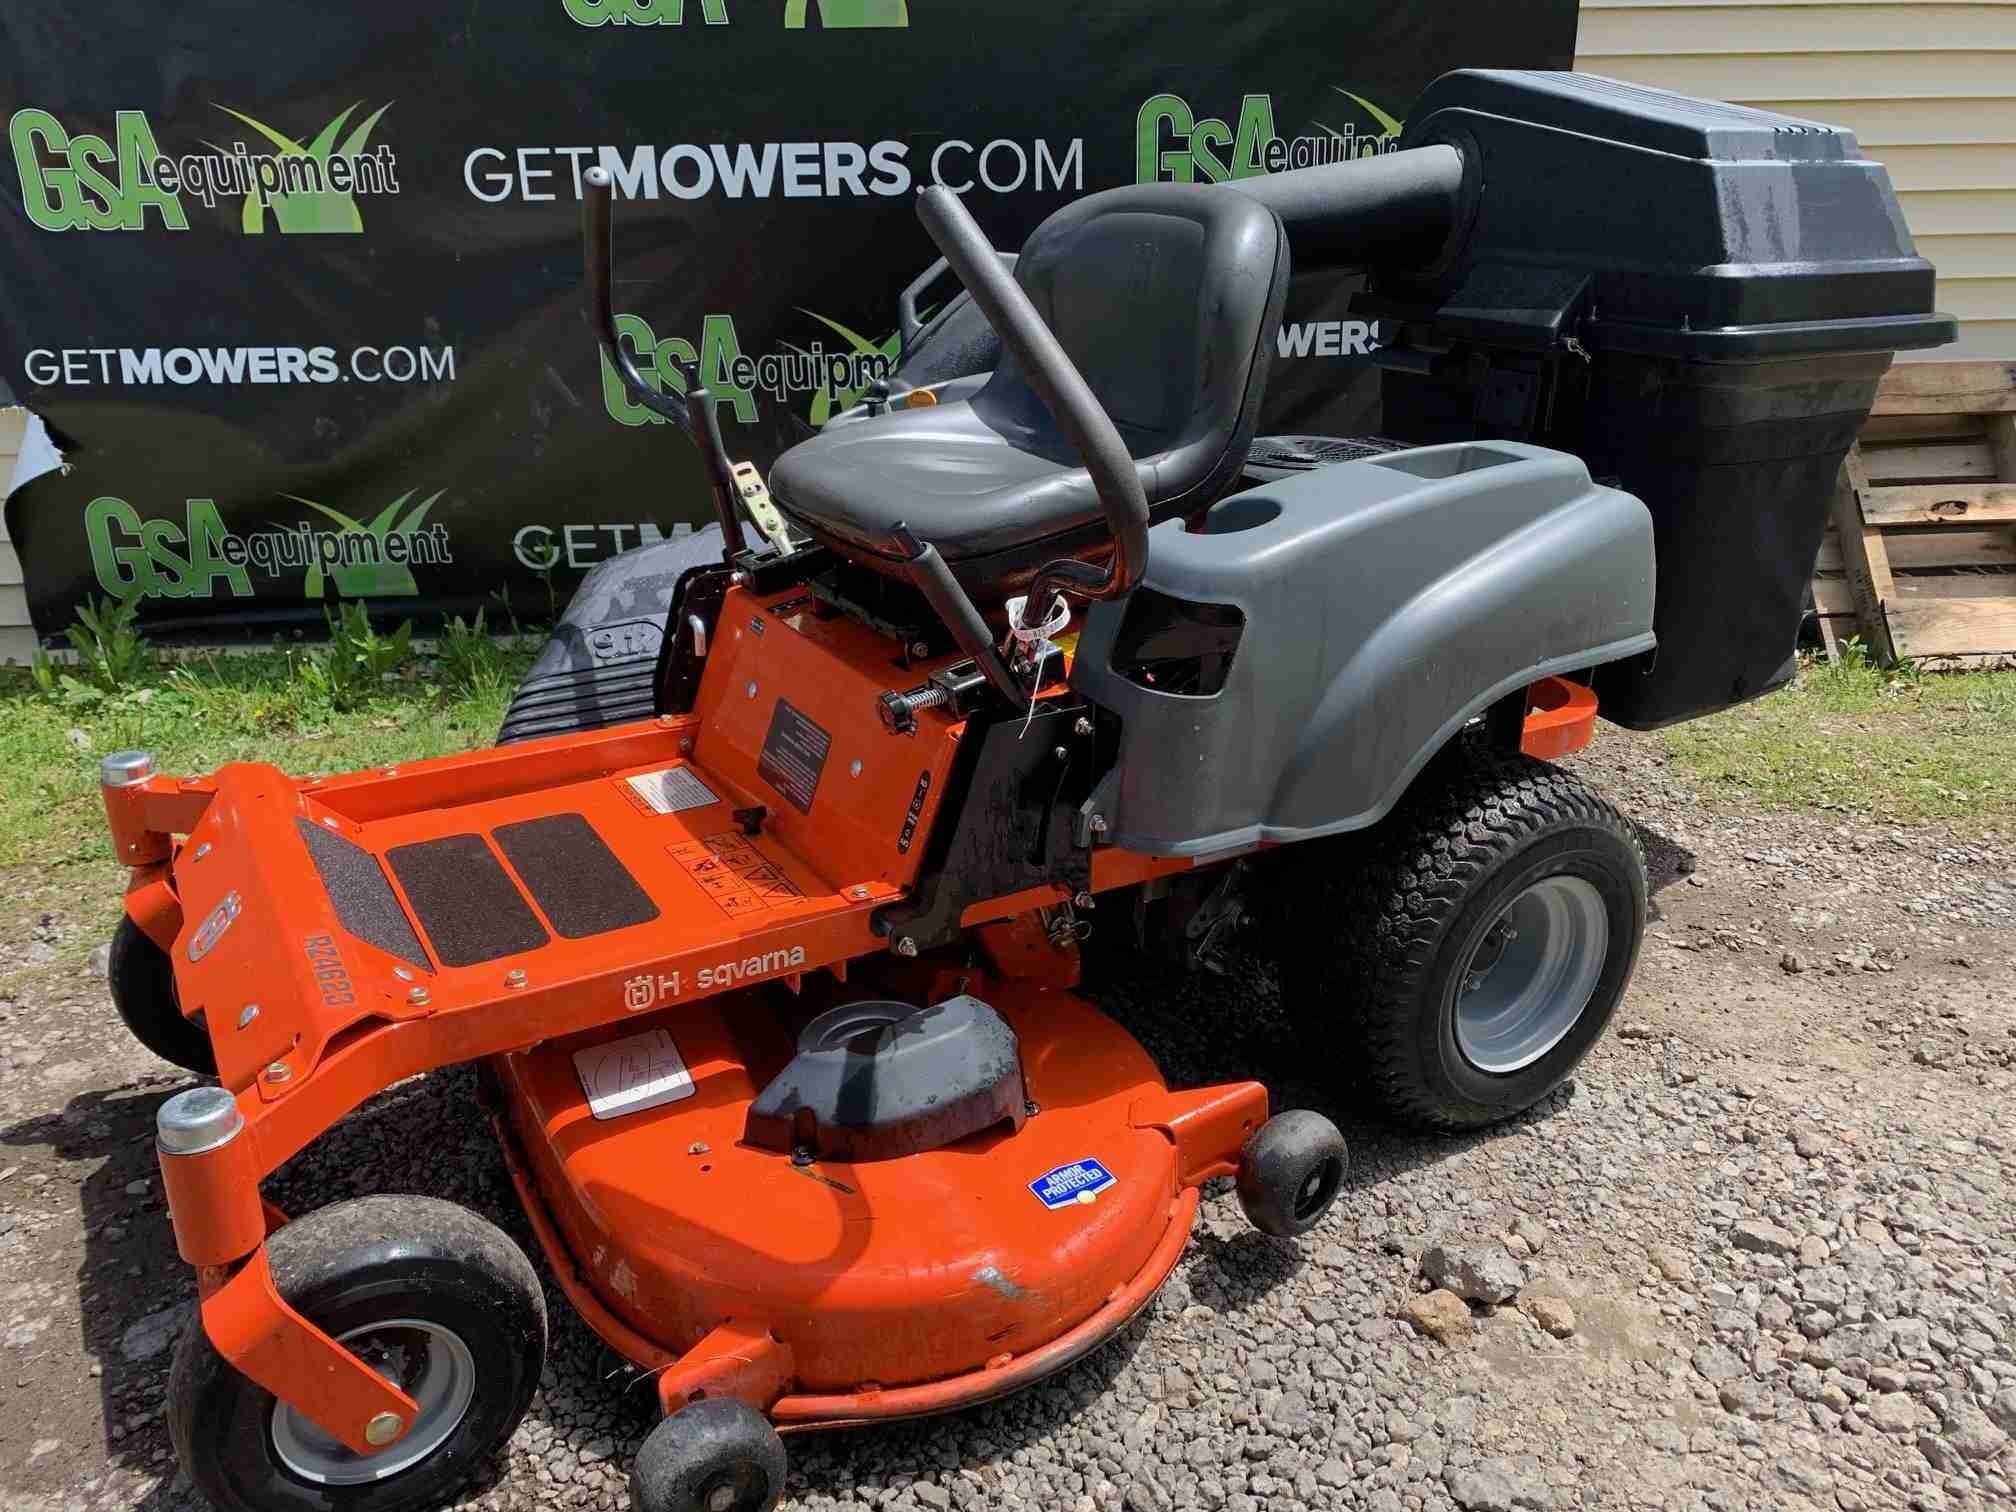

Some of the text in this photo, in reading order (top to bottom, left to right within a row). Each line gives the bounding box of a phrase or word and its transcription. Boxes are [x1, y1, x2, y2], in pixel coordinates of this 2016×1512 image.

[151, 142, 400, 208] equipment
[463, 138, 1084, 202] GETMOWERS.COM
[24, 345, 456, 386] GETMOWERS.COM
[221, 522, 453, 577] equipment
[1041, 1168, 1103, 1199] PROTECTED
[1045, 1164, 1086, 1187] ARMOR
